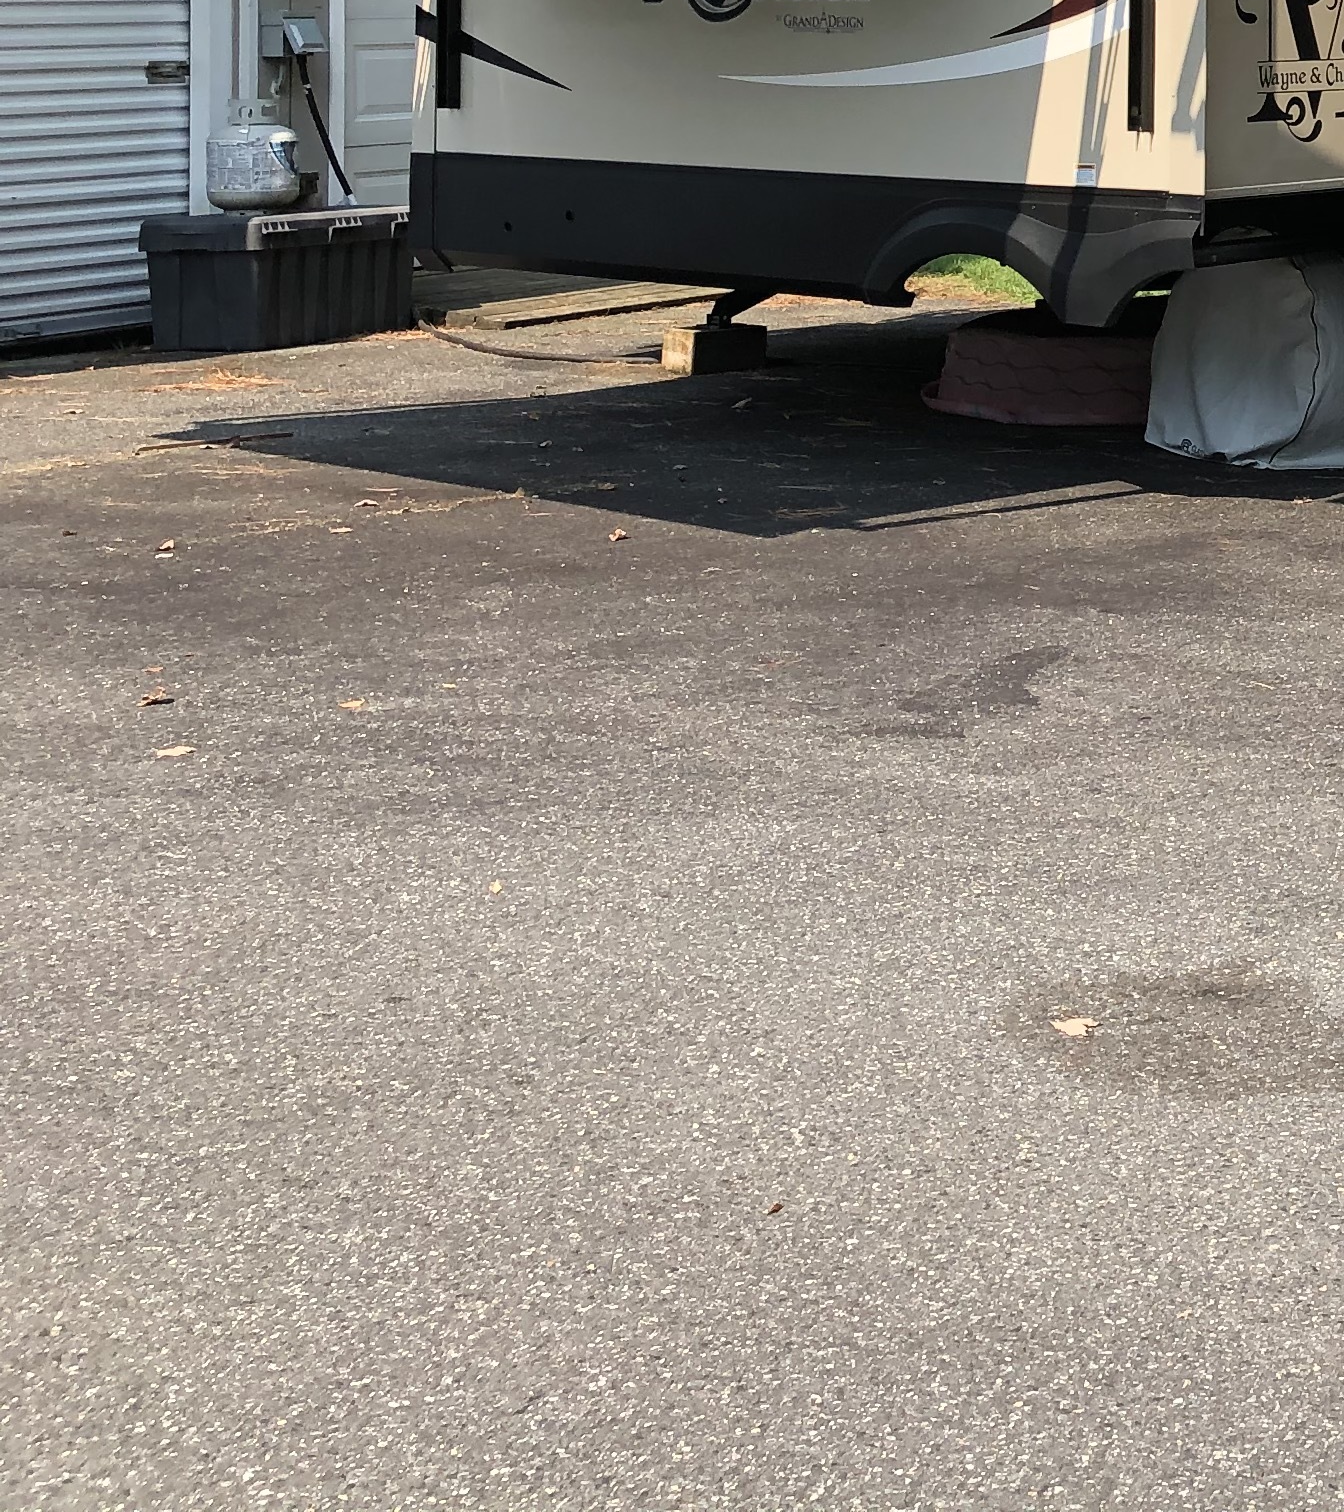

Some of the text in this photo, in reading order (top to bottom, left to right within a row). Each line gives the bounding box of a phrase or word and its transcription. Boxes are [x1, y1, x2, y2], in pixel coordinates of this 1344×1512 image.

[783, 14, 820, 28] GRAND
[828, 14, 864, 28] DESIGN
[1258, 64, 1307, 90] Wayne
[1310, 66, 1323, 84] &
